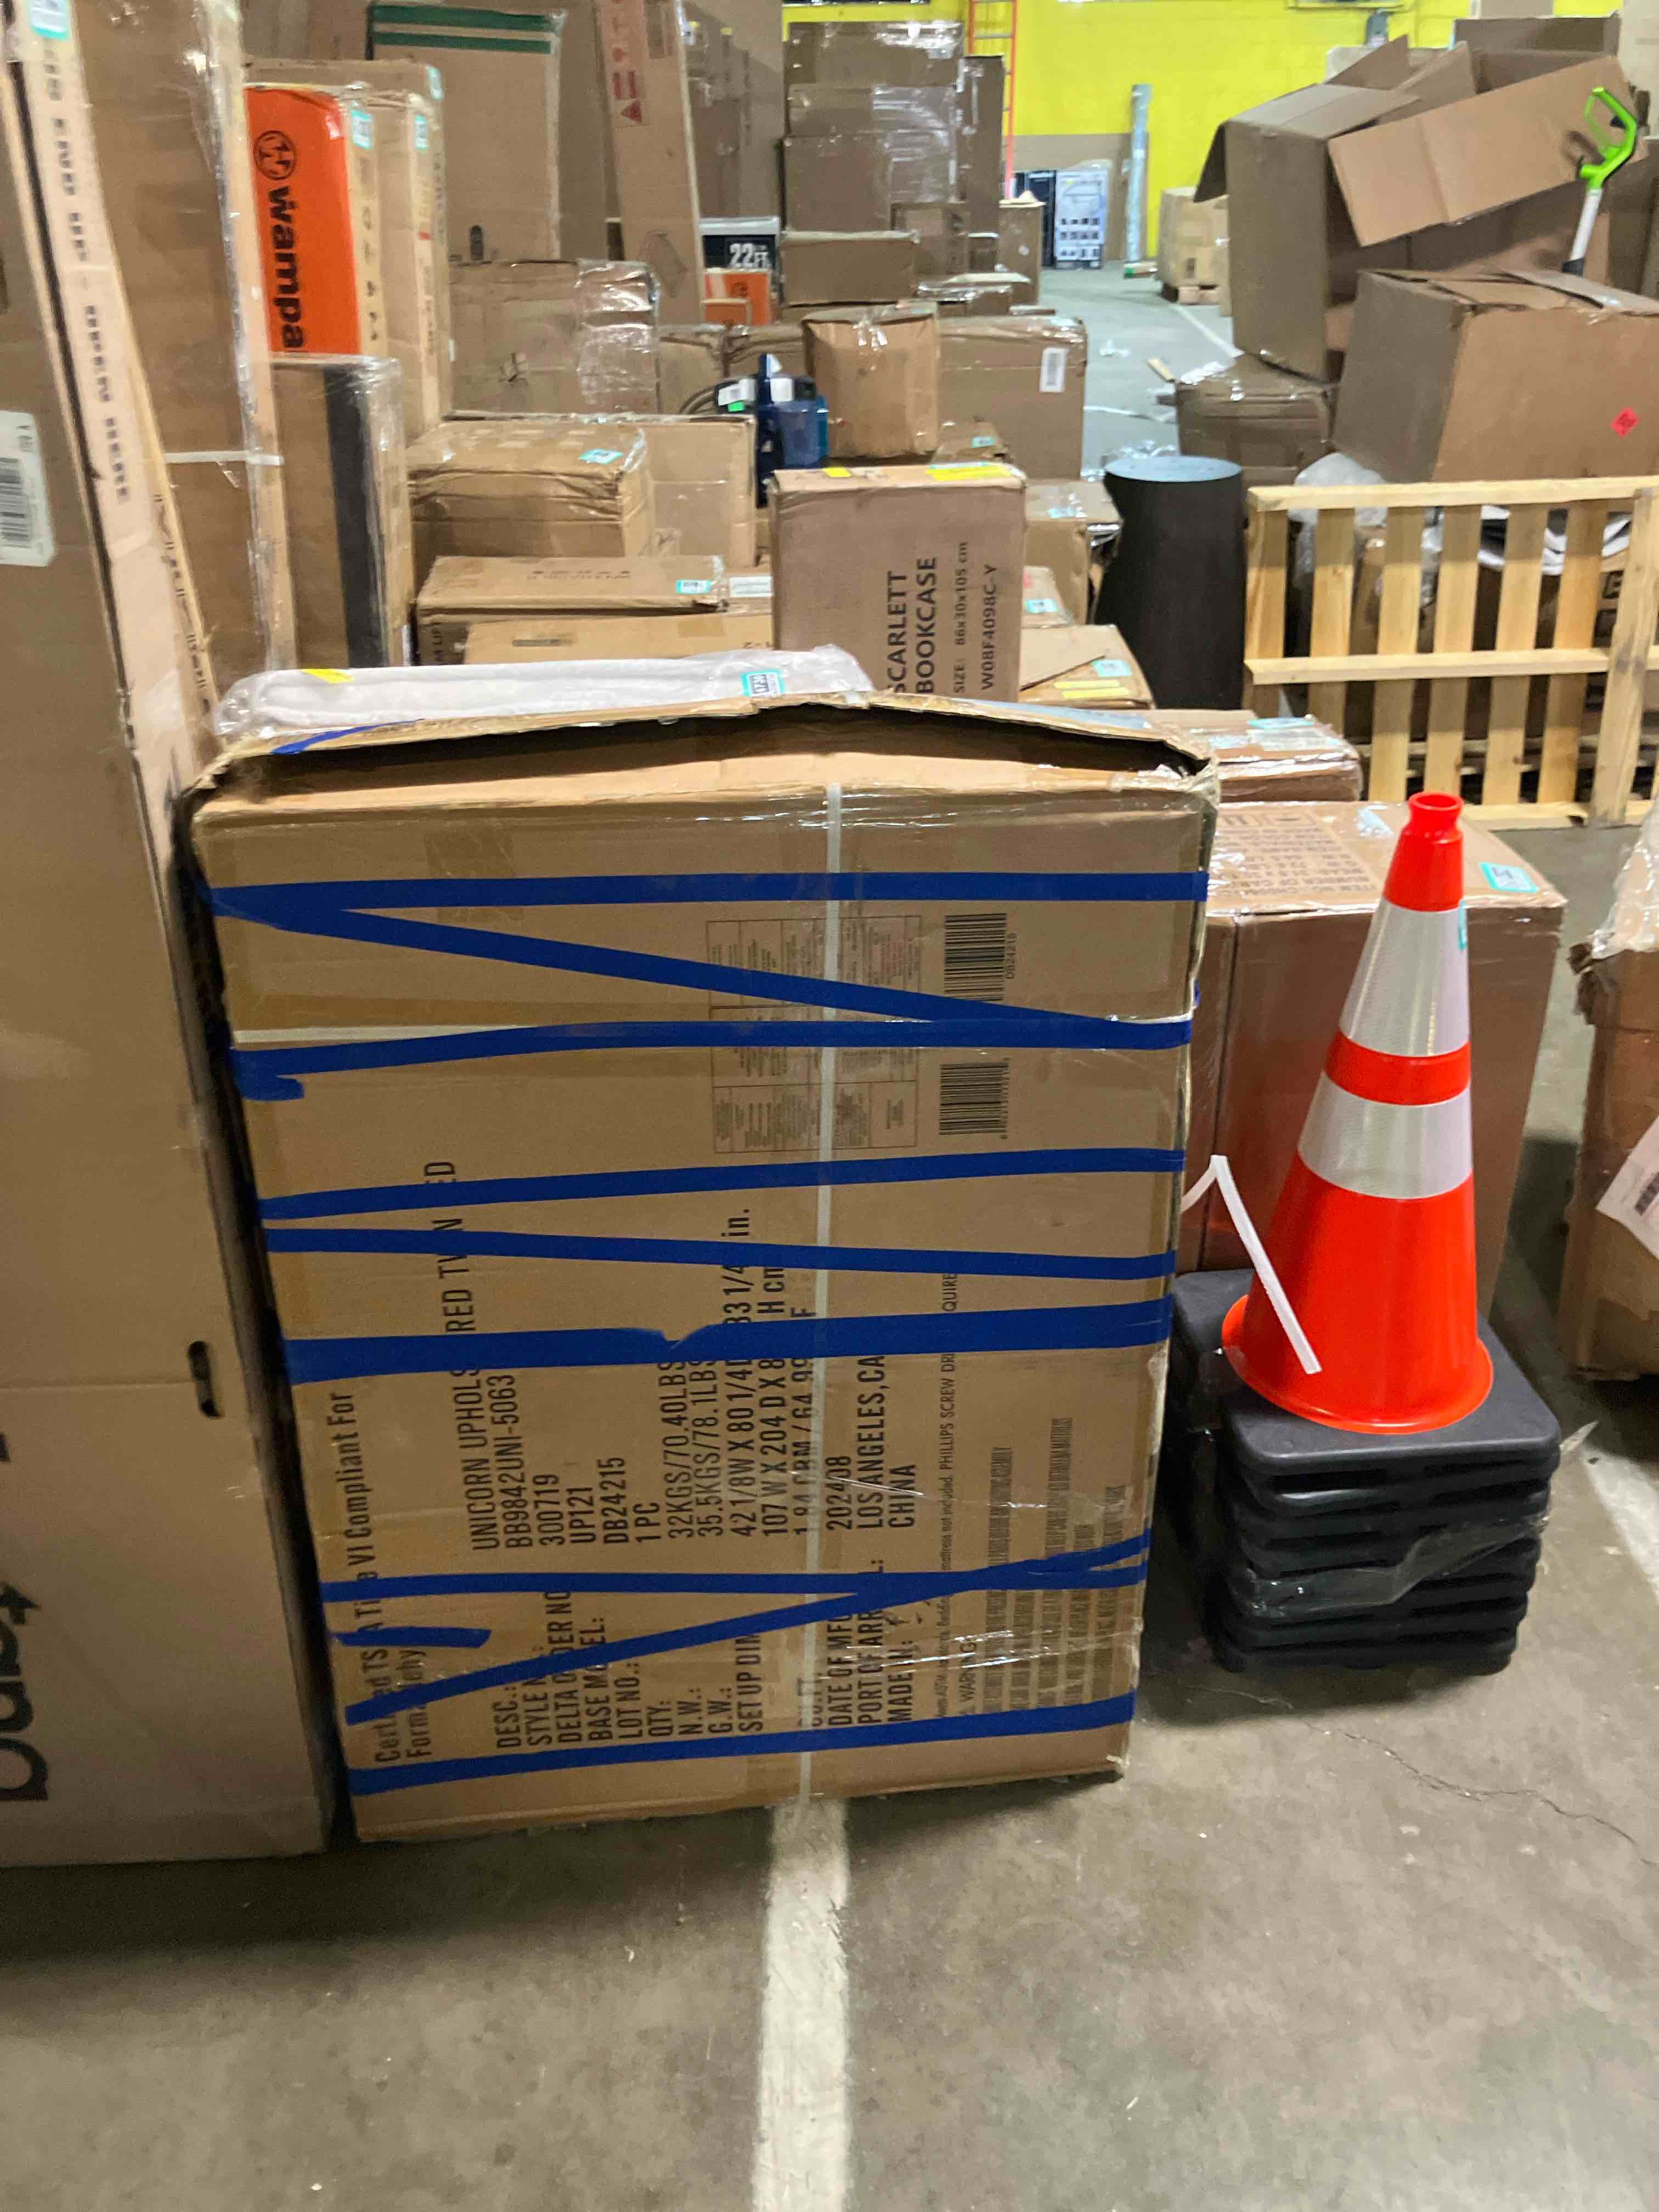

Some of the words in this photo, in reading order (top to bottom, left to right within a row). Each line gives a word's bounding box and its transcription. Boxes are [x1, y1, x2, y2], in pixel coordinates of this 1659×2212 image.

[268, 186, 306, 349] wampa
[729, 242, 754, 267] 22
[958, 542, 968, 563] cm
[887, 571, 907, 693] SCARLETT
[916, 557, 936, 693] BOOKCASE
[720, 1209, 750, 1237] in.
[757, 1301, 784, 1313] H
[442, 1289, 488, 1449] UPHOLSRED
[758, 1376, 785, 1388] X
[326, 1392, 357, 1426] For
[758, 1396, 785, 1408] D
[940, 1378, 956, 1418] SCREW
[726, 1408, 754, 1432] 80
[759, 1417, 787, 1455] 204
[487, 1374, 532, 1548] BB9842UNI-5063
[726, 1440, 754, 1451] X
[939, 1423, 955, 1470] PHILLIPS
[332, 1431, 373, 1538] Compliant
[759, 1462, 787, 1473] X
[461, 1458, 500, 1550] UNICORN
[598, 1458, 628, 1544] DB24215
[760, 1481, 787, 1496] W
[825, 1455, 852, 1530] 202408
[888, 1464, 916, 1528] CHINA
[533, 1474, 565, 1546] 300719
[566, 1487, 596, 1543] UP121
[633, 1503, 659, 1528] PC
[761, 1504, 788, 1536] 107
[858, 1492, 885, 1528] LOS
[940, 1518, 953, 1532] not
[346, 1544, 375, 1566] VI
[938, 1536, 953, 1571] mattress
[353, 1571, 382, 1620] Tie
[357, 1622, 388, 1673] TSA
[857, 1652, 883, 1673] OF
[736, 1672, 761, 1695] UP
[826, 1657, 852, 1677] OF
[827, 1684, 852, 1725] DATE
[857, 1681, 882, 1724] PORT
[887, 1672, 913, 1722] MADE
[364, 1677, 400, 1763] Certed
[523, 1693, 552, 1746] STYLE
[554, 1690, 582, 1743] DELTA
[584, 1695, 613, 1741] BASE
[617, 1708, 642, 1739] LOT
[646, 1701, 673, 1737] QTY:
[737, 1701, 763, 1733] SET
